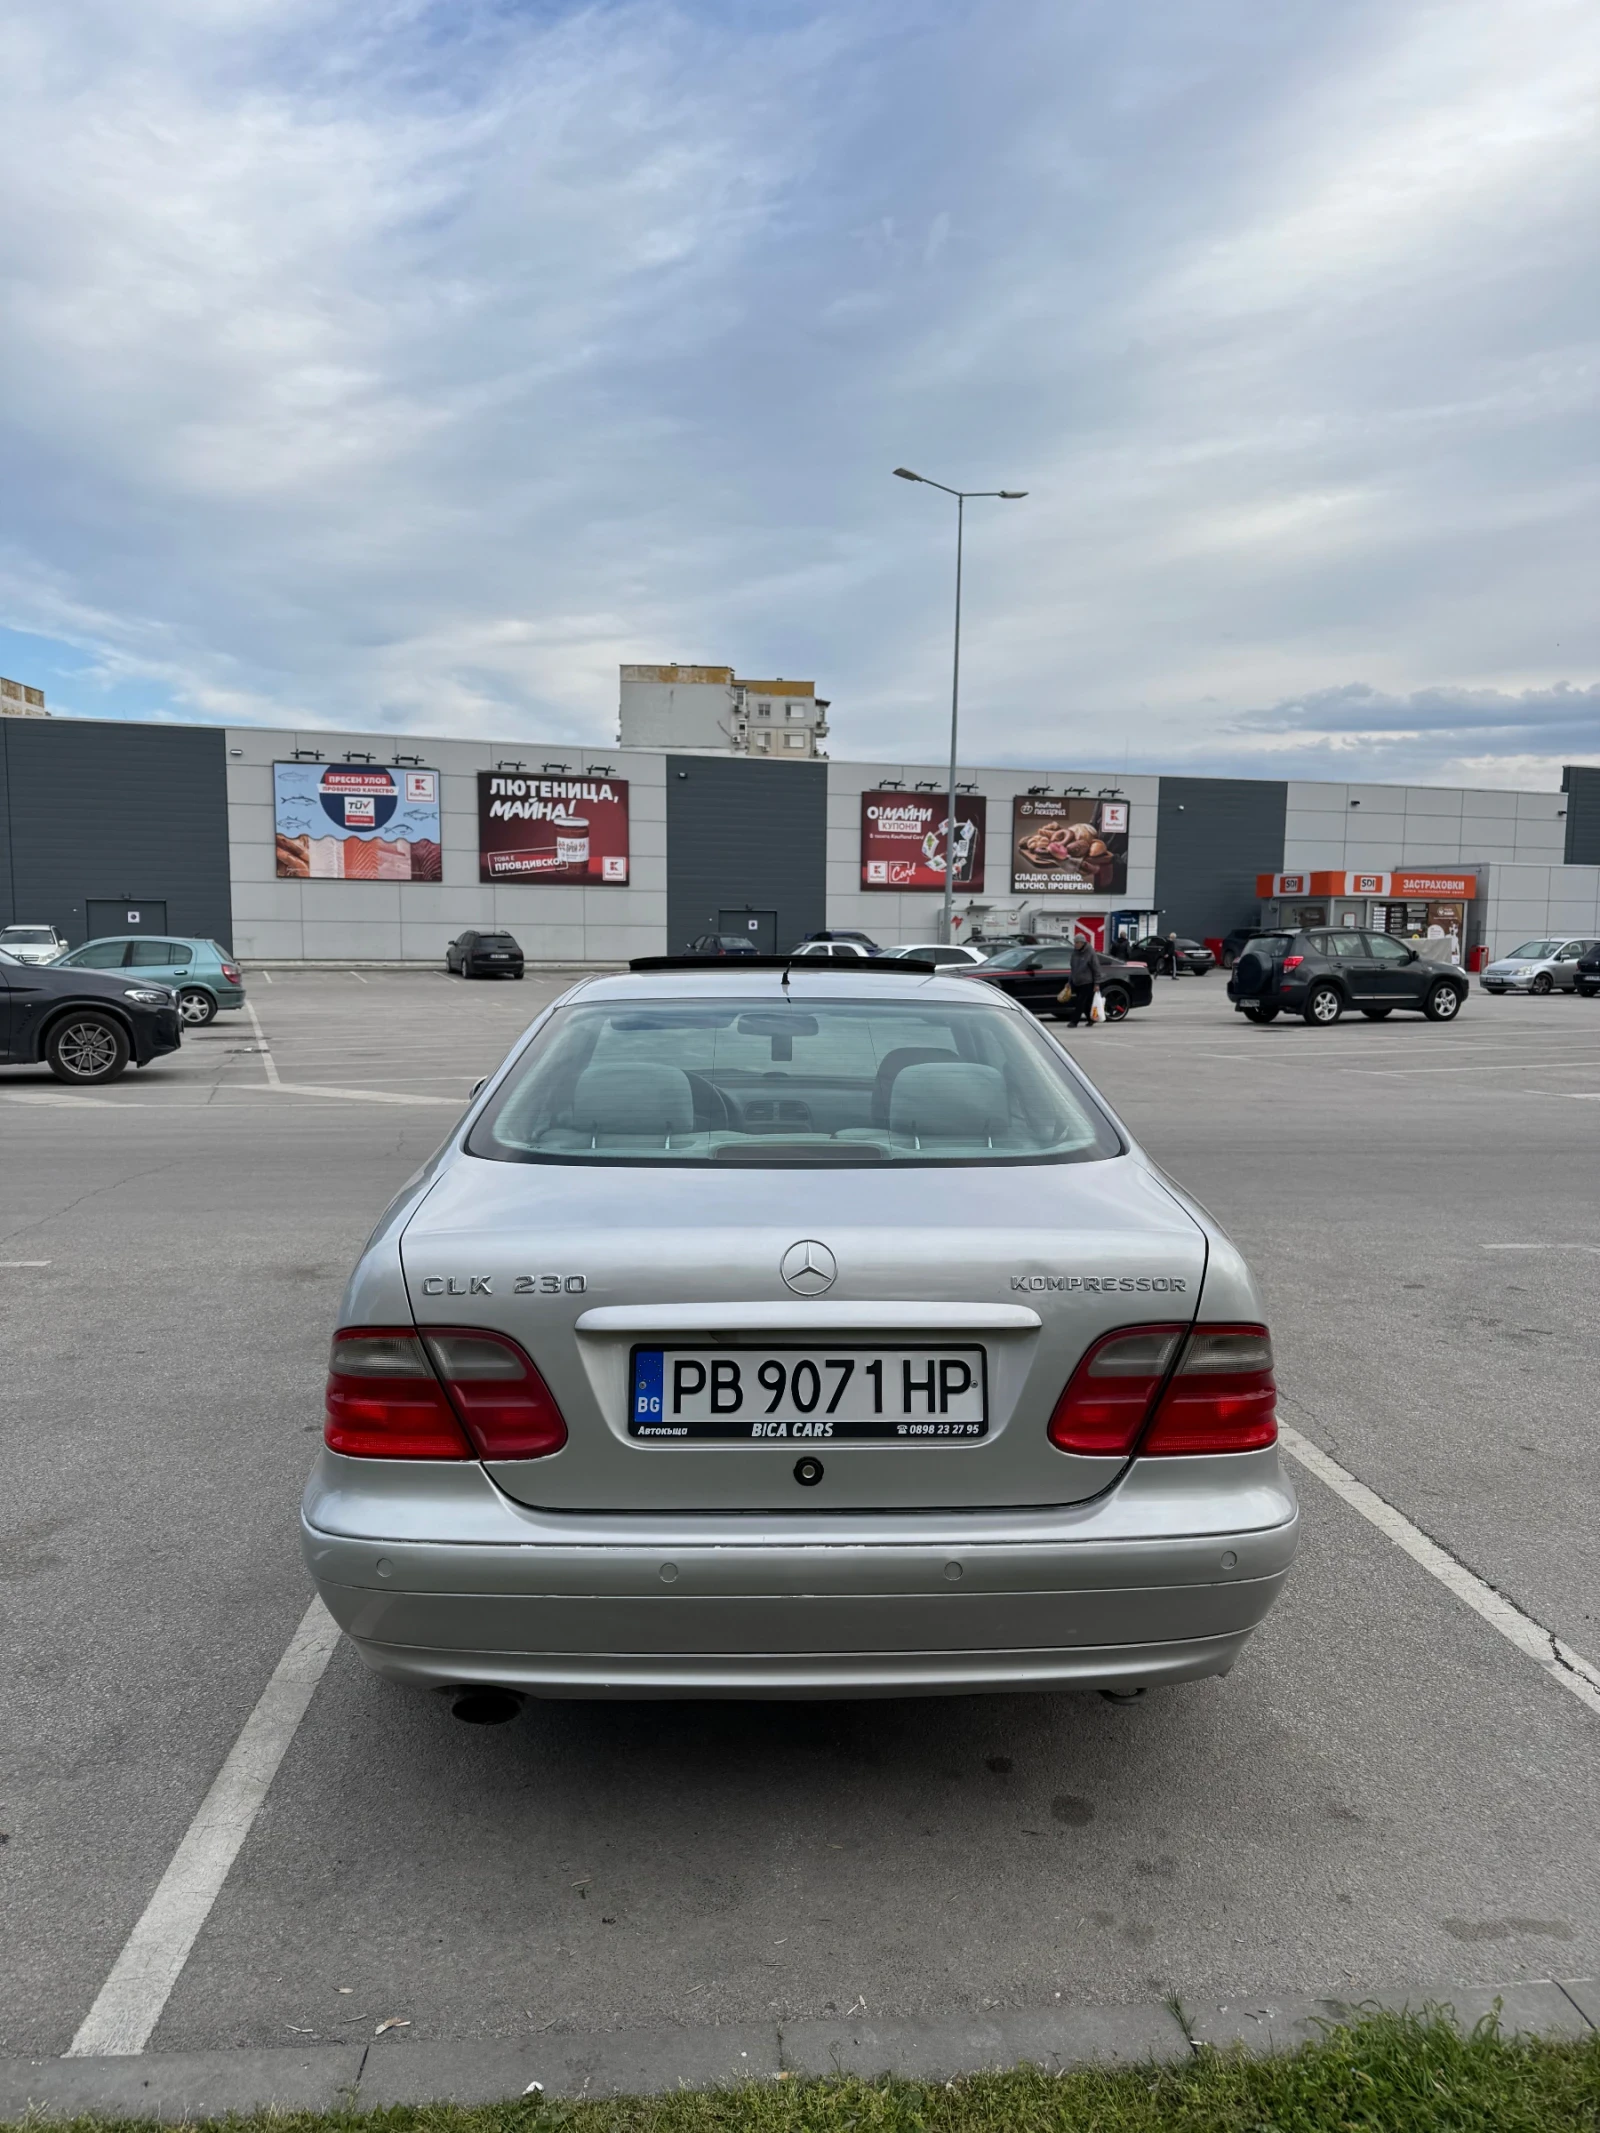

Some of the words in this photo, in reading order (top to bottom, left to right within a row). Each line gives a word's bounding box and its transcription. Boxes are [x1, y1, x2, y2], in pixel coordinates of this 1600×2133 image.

[328, 775, 363, 784] ПРЕСЕН
[363, 776, 387, 785] УЛОВ
[489, 778, 619, 803] ЛЮТЕНИЦА,
[489, 797, 577, 821] МАЙНА!
[1034, 800, 1062, 809] Kaufland
[882, 822, 918, 831] КУПОНИ
[891, 862, 917, 881] Card
[1014, 873, 1049, 882] СЛАДКО.
[1050, 873, 1084, 882] СОЛЕНО.
[1361, 878, 1375, 888] SDI
[1014, 882, 1047, 890] ВКУСНО.
[1047, 882, 1095, 891] ПРОВЕРЕНО.
[1285, 879, 1298, 889] SDI
[1403, 879, 1465, 890] ЗАСТРАХОВКИ
[422, 1275, 493, 1296] CLK
[513, 1274, 588, 1294] 230
[1010, 1276, 1187, 1293] KOMPRESSOR
[673, 1359, 744, 1414] PB
[757, 1359, 883, 1414] 9071
[902, 1359, 972, 1414] HP
[637, 1396, 660, 1413] BG
[637, 1425, 688, 1436] Автокъща
[751, 1422, 788, 1437] BICA
[792, 1422, 834, 1437] CARS
[909, 1424, 935, 1435] 0898
[936, 1424, 950, 1435] 23
[951, 1424, 965, 1435] 27
[966, 1424, 980, 1435] 95
